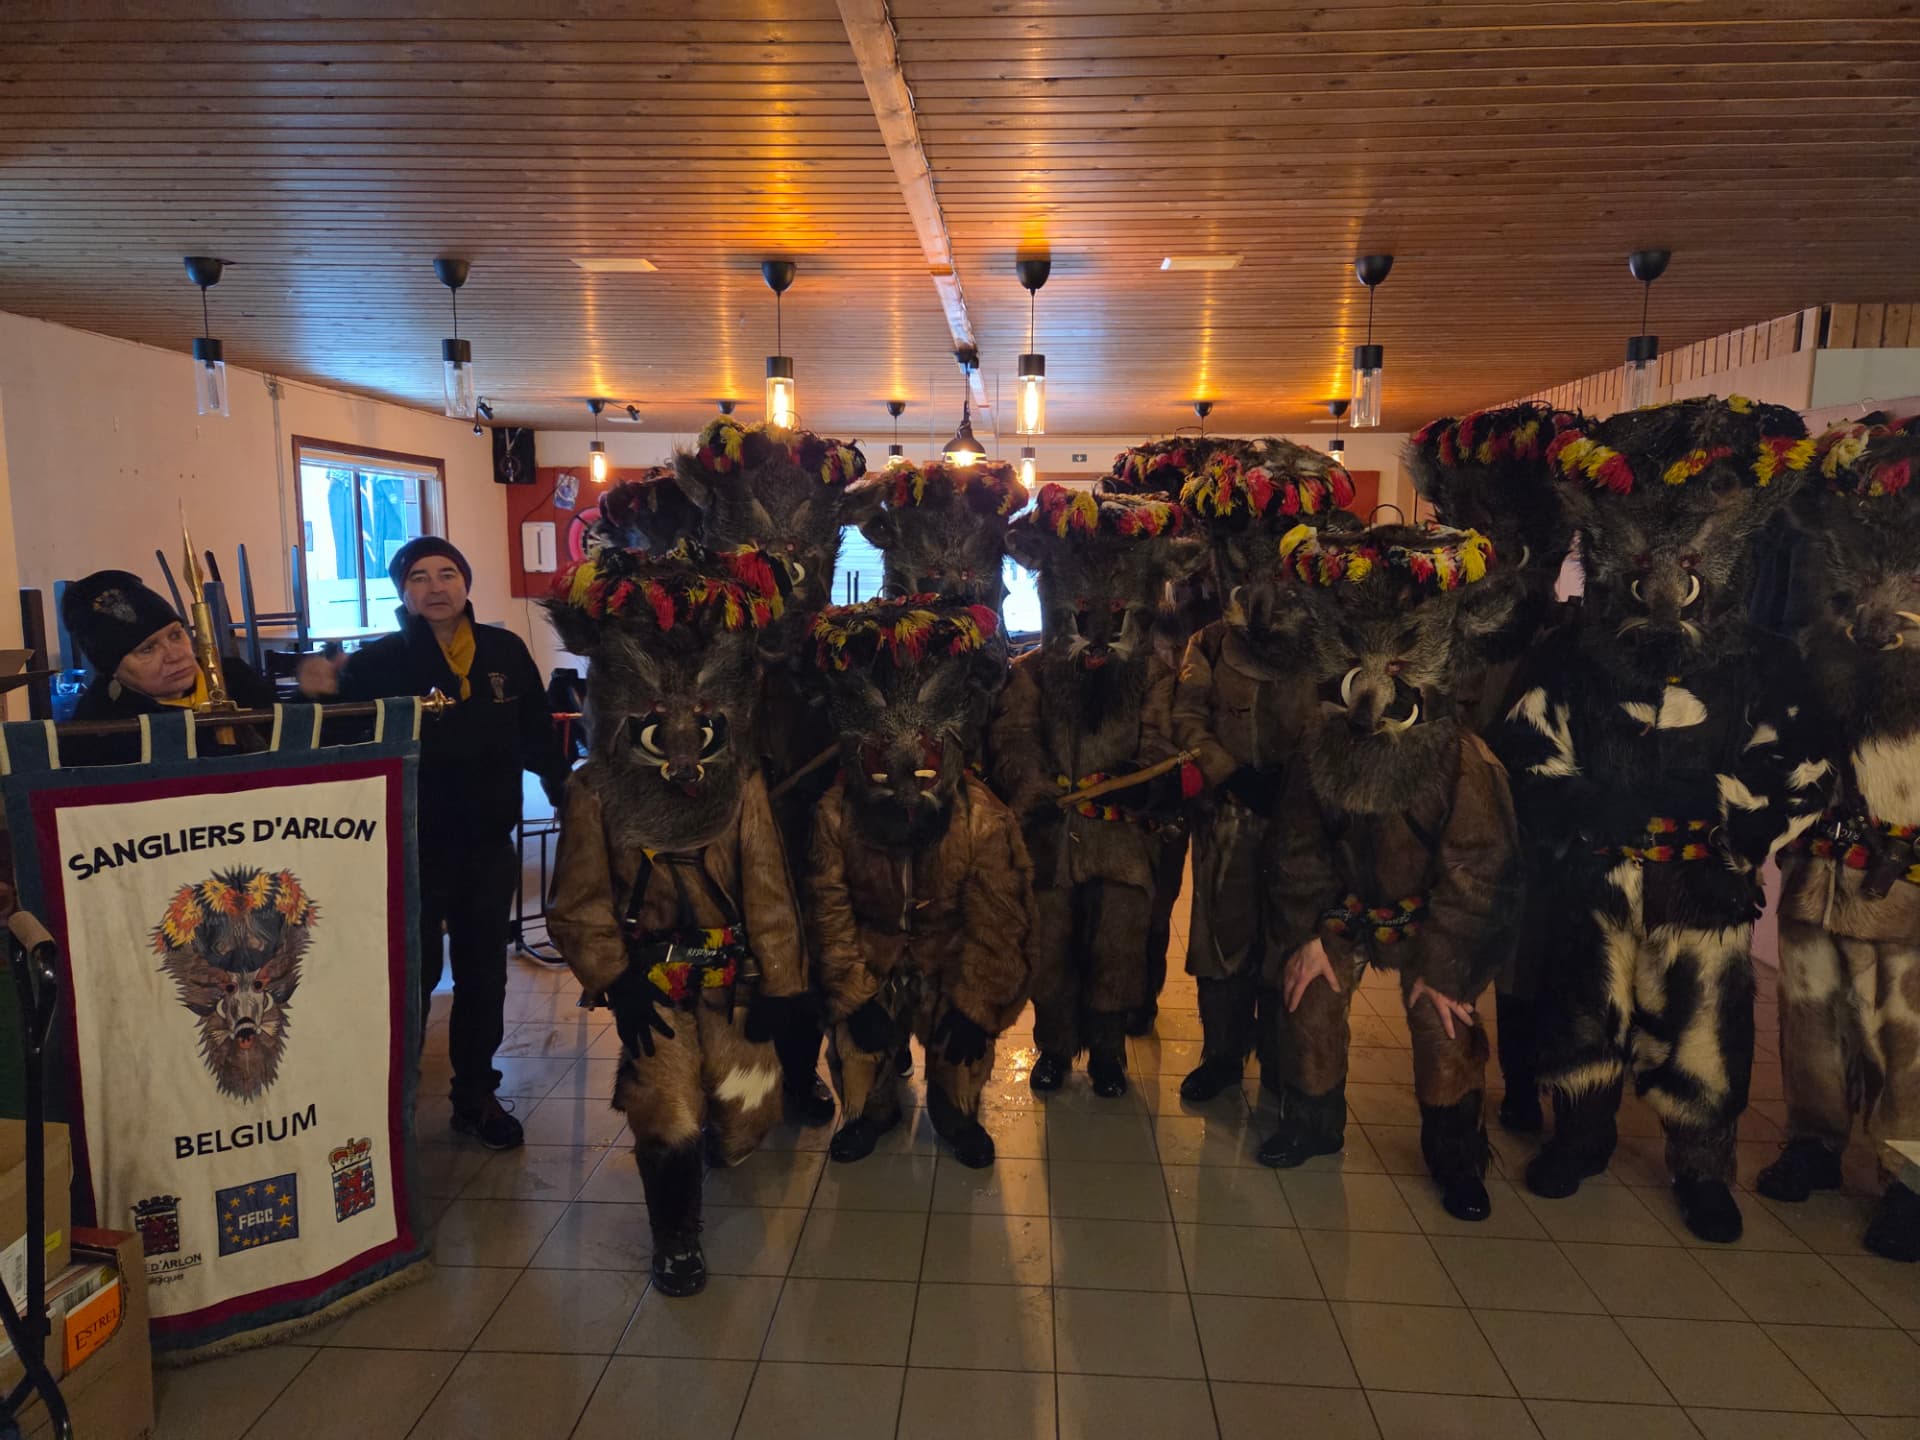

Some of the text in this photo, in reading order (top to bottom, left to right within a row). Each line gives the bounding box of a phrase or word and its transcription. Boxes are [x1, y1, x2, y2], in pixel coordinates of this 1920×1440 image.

[68, 816, 377, 881] SANGLIERS D'ARLON
[174, 1103, 318, 1160] BELGIUM
[238, 1207, 273, 1230] FECC
[150, 1252, 202, 1272] D'ARLON
